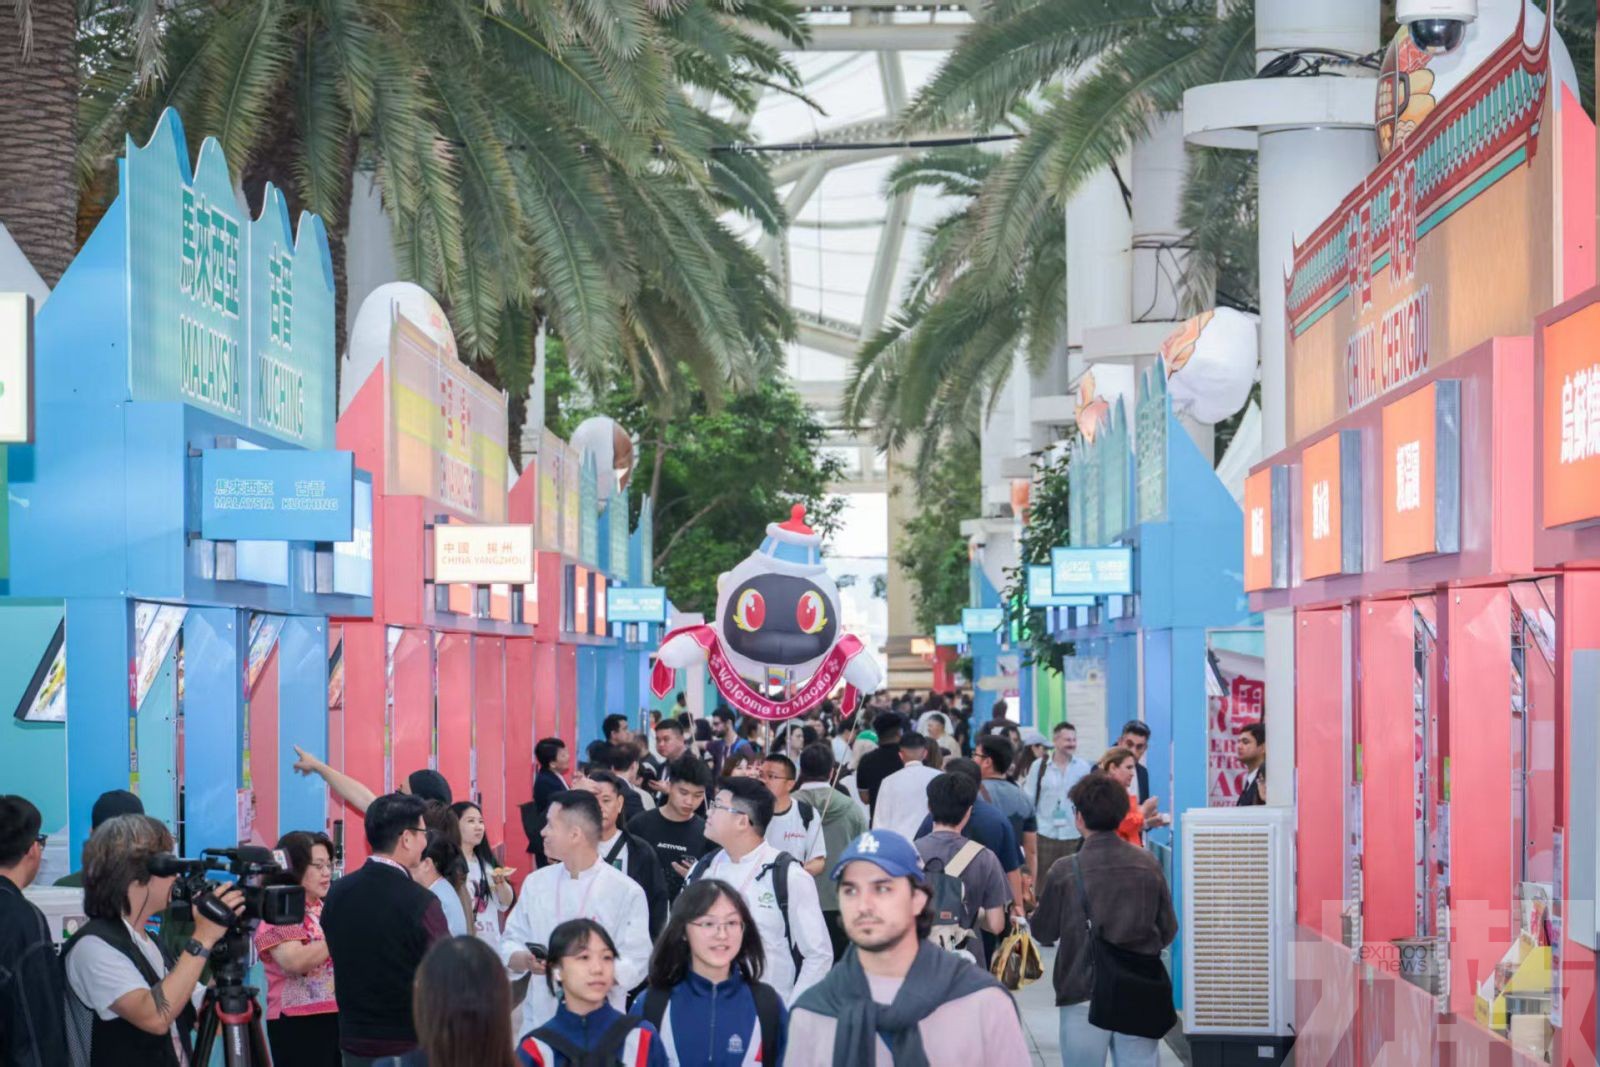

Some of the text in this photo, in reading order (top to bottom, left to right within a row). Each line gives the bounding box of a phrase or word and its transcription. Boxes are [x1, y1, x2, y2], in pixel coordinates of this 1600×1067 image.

[180, 184, 293, 350] 馬來西亞 古晉
[1347, 283, 1429, 414] CHINA CHENGDU
[180, 313, 303, 440] MALAYSIA KUCHING
[214, 478, 325, 497] 馬來西亞 古晉
[214, 496, 338, 511] MALAYSIA KUCHING
[441, 556, 526, 566] CHINA YANGZHOU
[718, 666, 832, 715] Welcome to Macao
